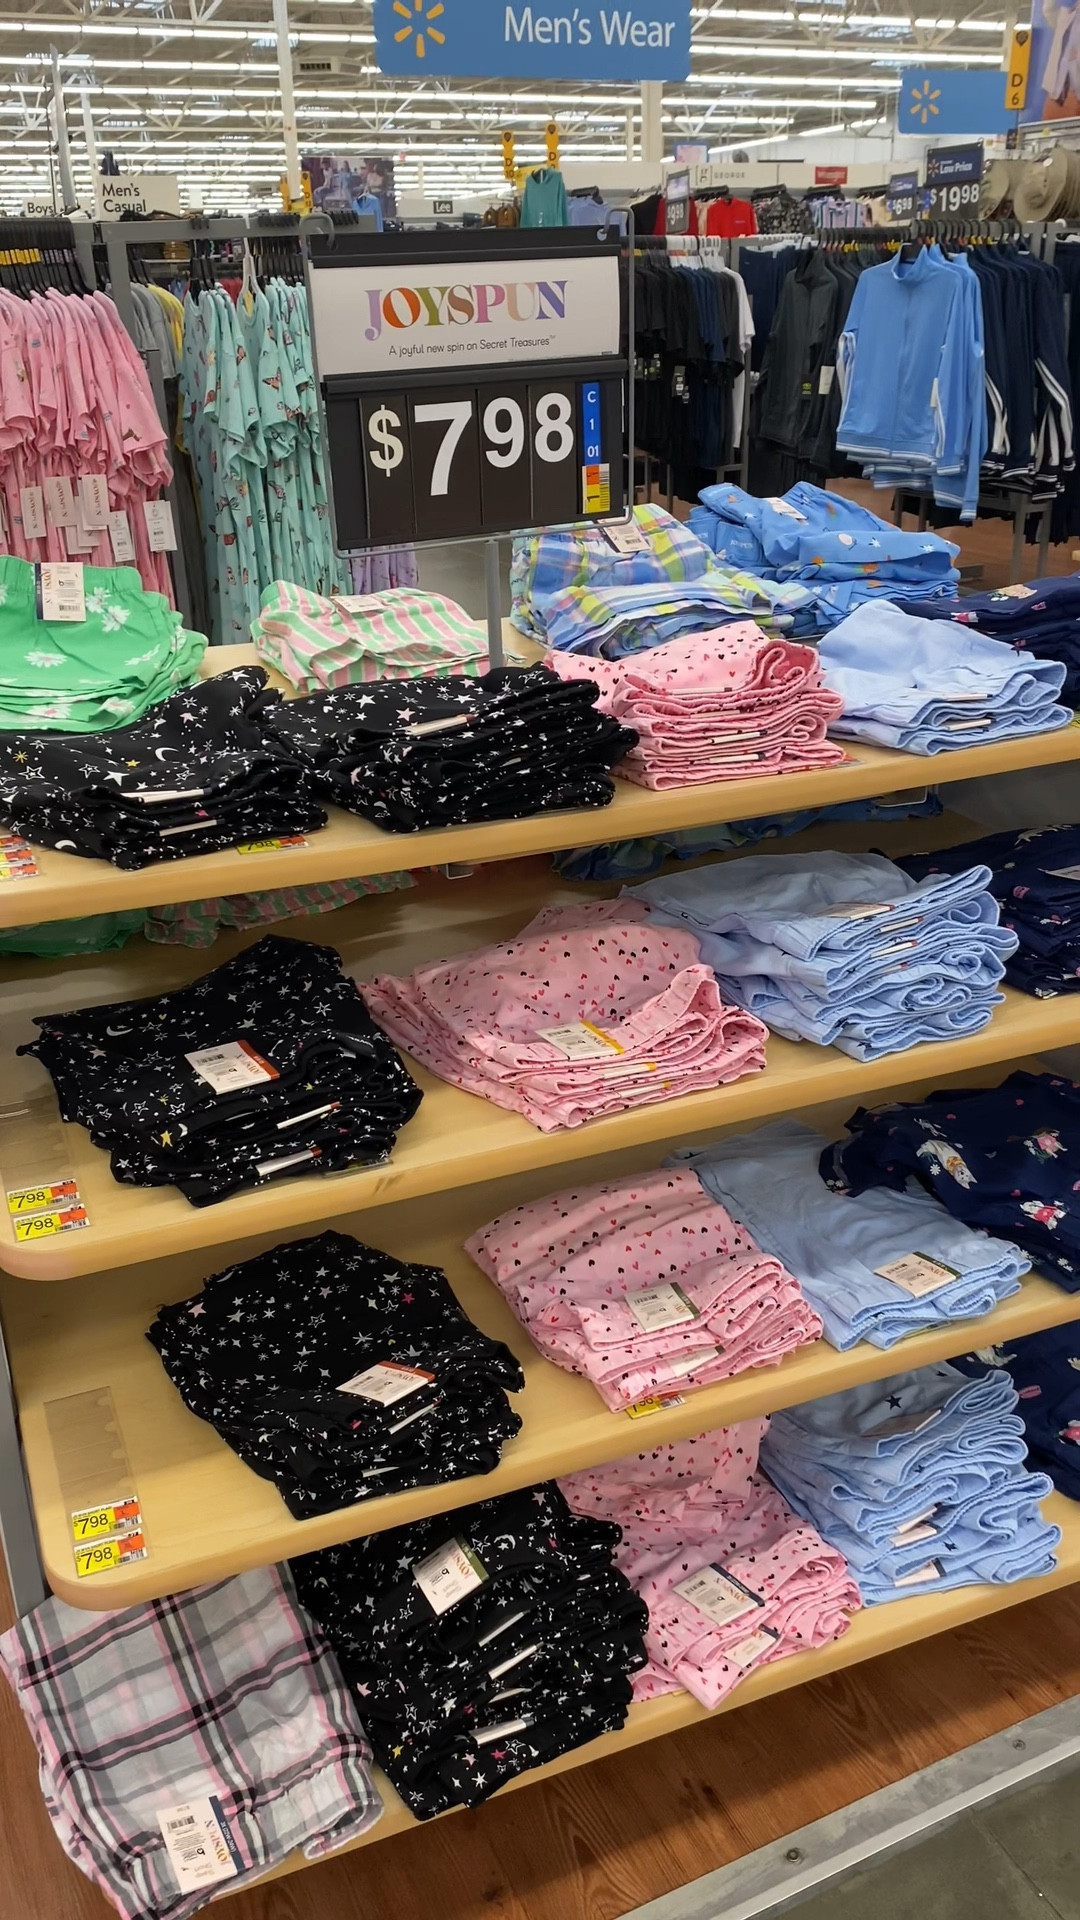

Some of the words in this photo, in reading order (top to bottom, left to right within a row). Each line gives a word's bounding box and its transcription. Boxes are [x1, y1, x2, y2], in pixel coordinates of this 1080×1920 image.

[504, 6, 592, 45] Men's
[600, 10, 676, 48] Wear
[1011, 73, 1024, 88] D
[1011, 92, 1020, 106] 6
[102, 183, 140, 197] Men's
[103, 199, 147, 213] Casual
[434, 201, 451, 213] Lee
[364, 280, 569, 341] JOYSPUN
[389, 345, 397, 356] A
[399, 344, 425, 358] joyful
[426, 345, 445, 353] new
[447, 341, 465, 354] spin
[466, 343, 478, 351] on
[479, 339, 508, 350] Secret
[587, 391, 596, 403] C
[589, 418, 595, 431] 1
[587, 445, 600, 458] 01
